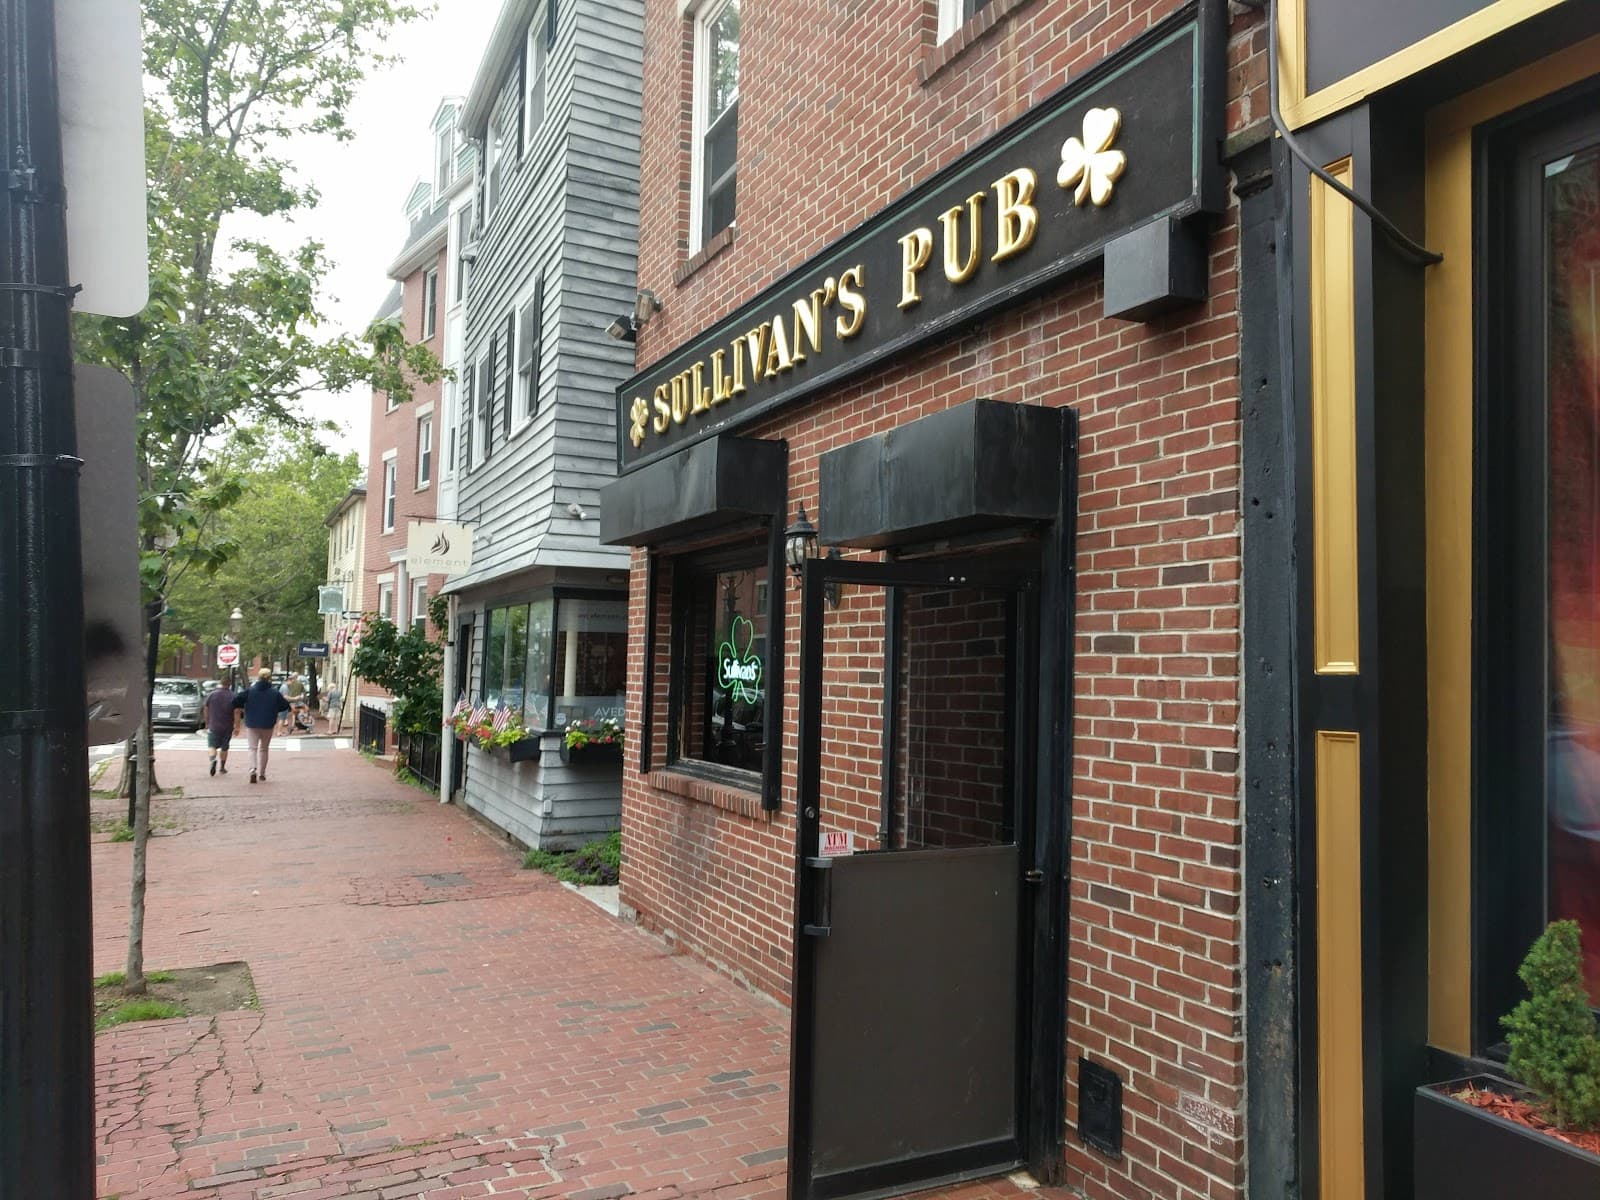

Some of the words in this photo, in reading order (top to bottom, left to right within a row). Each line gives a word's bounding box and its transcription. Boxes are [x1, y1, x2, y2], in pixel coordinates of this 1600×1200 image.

[653, 265, 867, 433] SULLIVAN'S
[897, 168, 1038, 308] PUB
[410, 557, 467, 568] element
[826, 832, 847, 846] ATM
